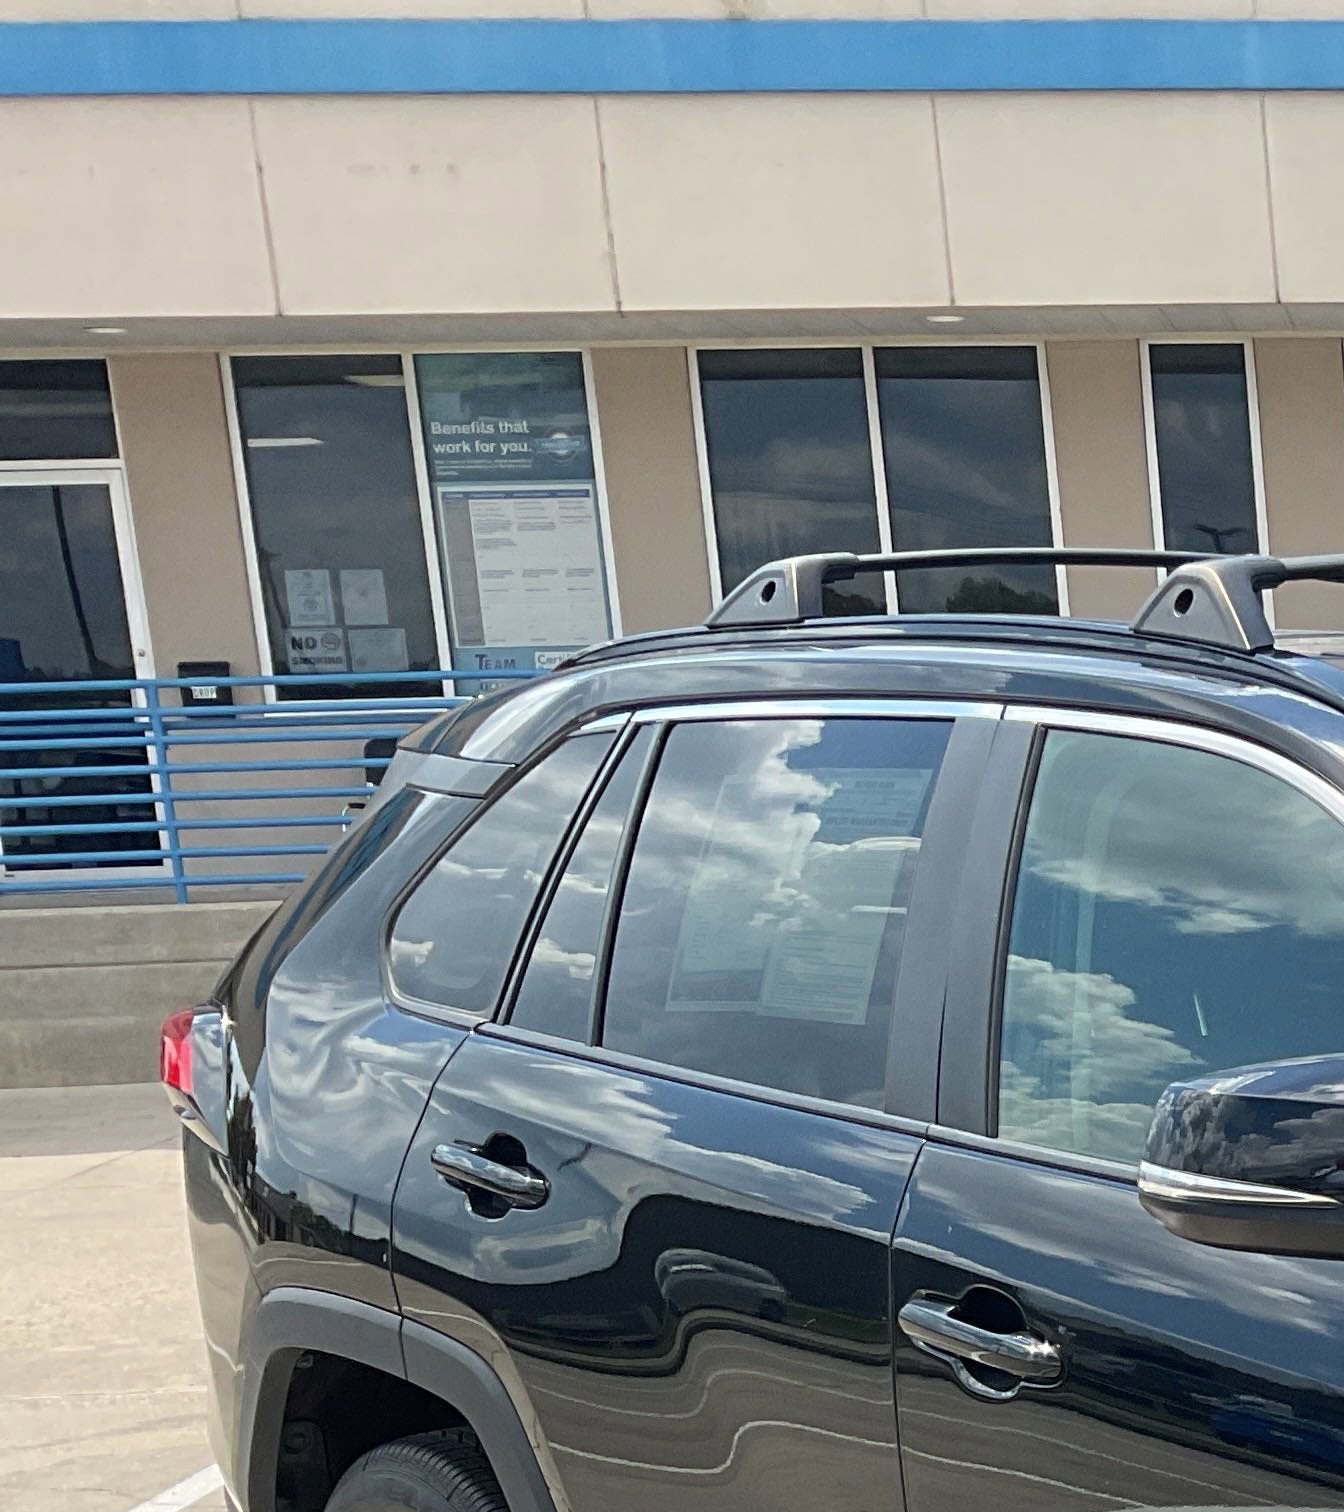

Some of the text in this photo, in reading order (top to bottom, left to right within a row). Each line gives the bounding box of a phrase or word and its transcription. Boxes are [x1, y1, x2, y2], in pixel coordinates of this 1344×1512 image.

[430, 420, 530, 435] Benefits that
[433, 440, 471, 454] work
[475, 439, 496, 453] for
[502, 440, 532, 456] you.
[291, 636, 318, 650] NO
[475, 654, 516, 670] TEAM
